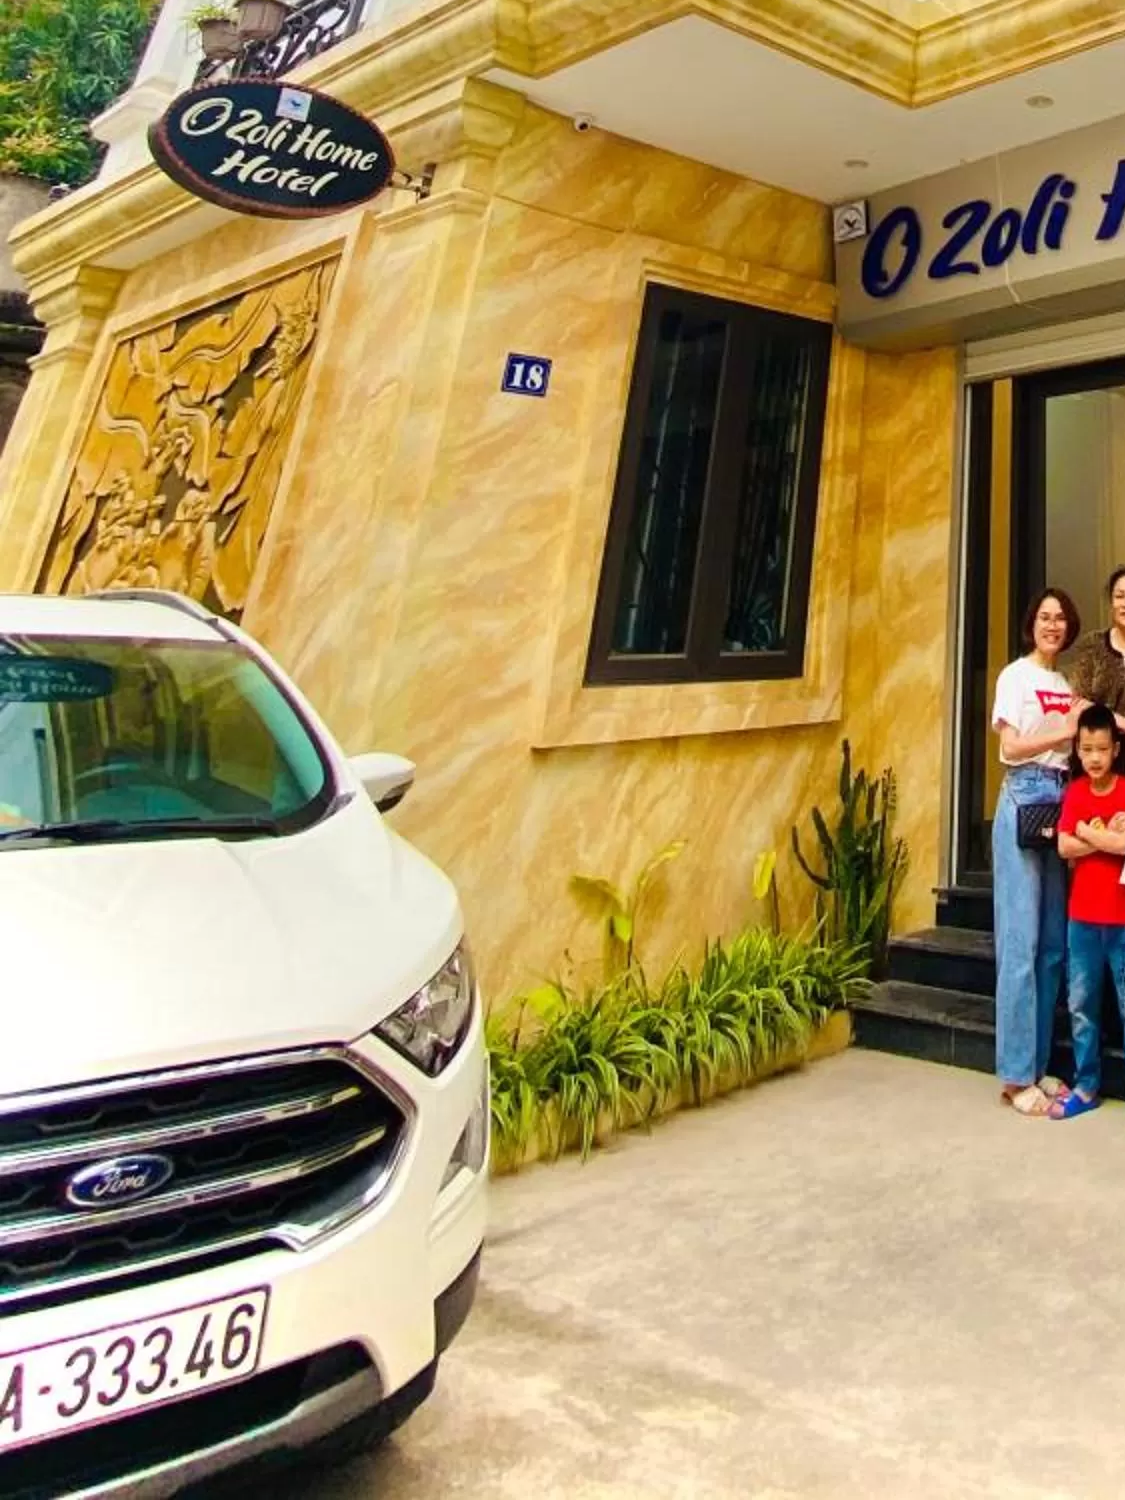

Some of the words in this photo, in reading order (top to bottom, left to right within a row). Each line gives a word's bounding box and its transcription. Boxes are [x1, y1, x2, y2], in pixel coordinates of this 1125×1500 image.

[180, 98, 233, 136] O
[225, 109, 292, 150] Zoli
[289, 122, 378, 171] Home
[211, 149, 339, 197] Hotel
[861, 206, 922, 298] O
[927, 173, 1077, 280] Zoli
[508, 362, 543, 390] 18
[93, 1165, 151, 1197] Ford
